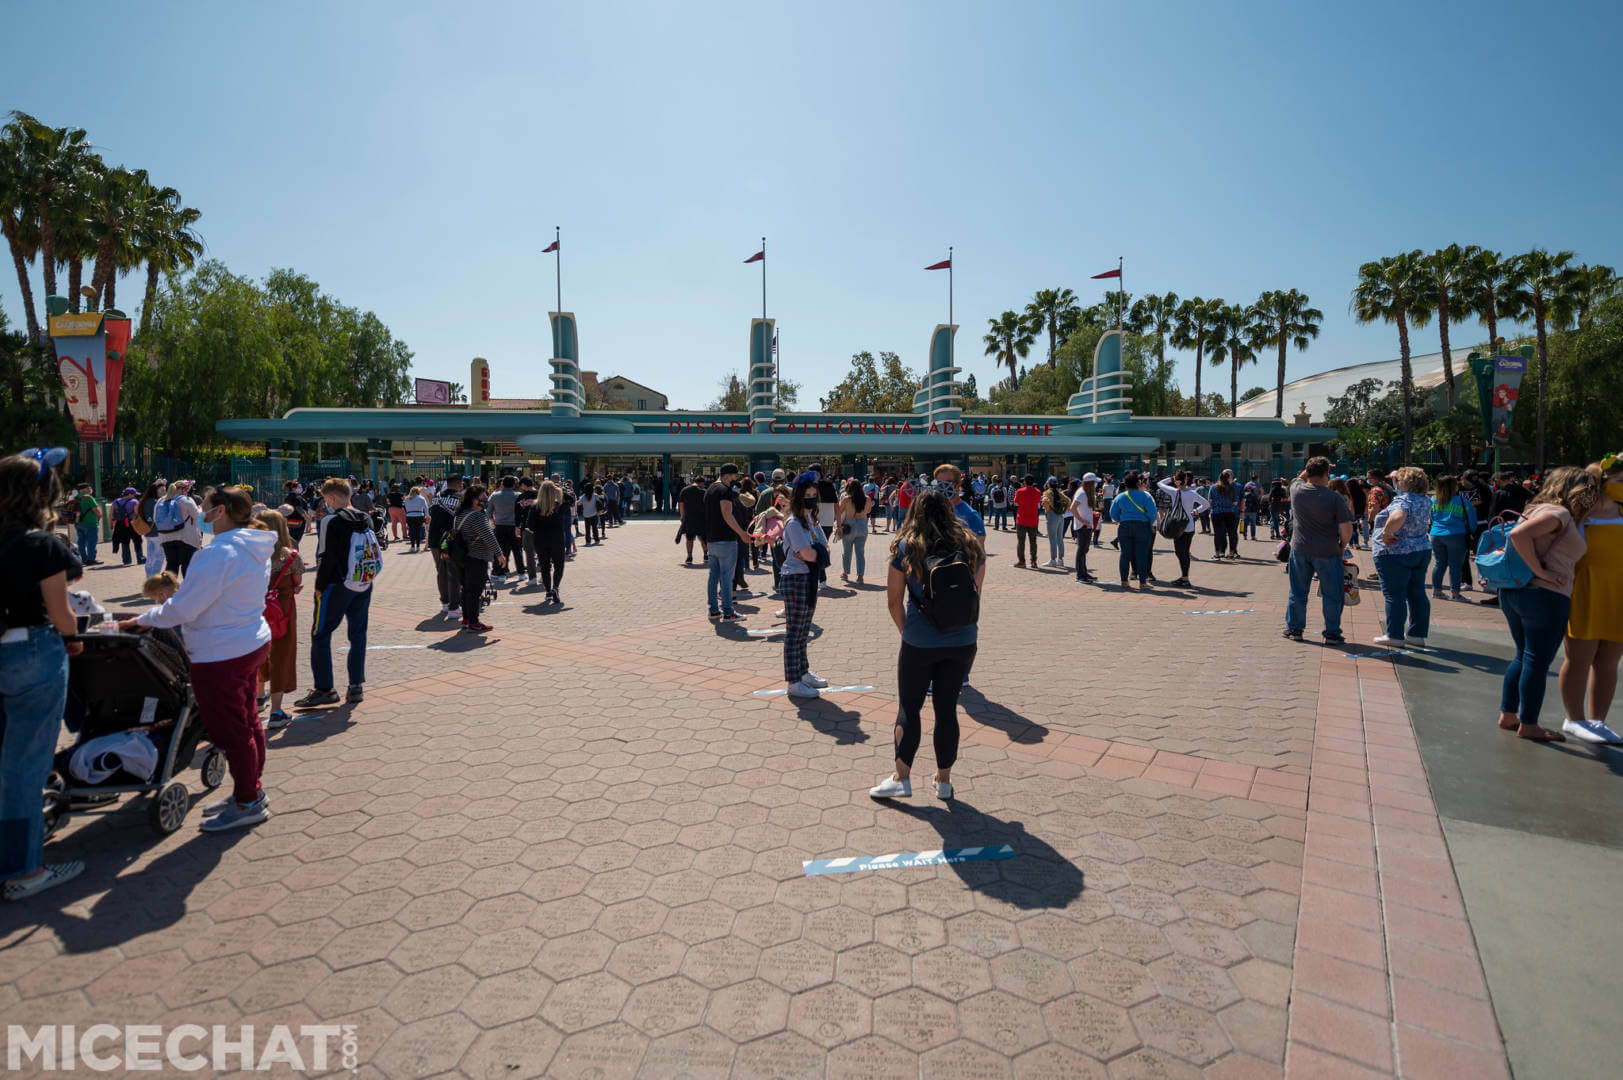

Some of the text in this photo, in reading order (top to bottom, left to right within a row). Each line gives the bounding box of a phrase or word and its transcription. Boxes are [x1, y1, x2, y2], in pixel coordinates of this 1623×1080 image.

[669, 420, 1053, 436] DISNEY CALIFORNIA ADVENTURE
[859, 856, 966, 871] Please WAIT Here
